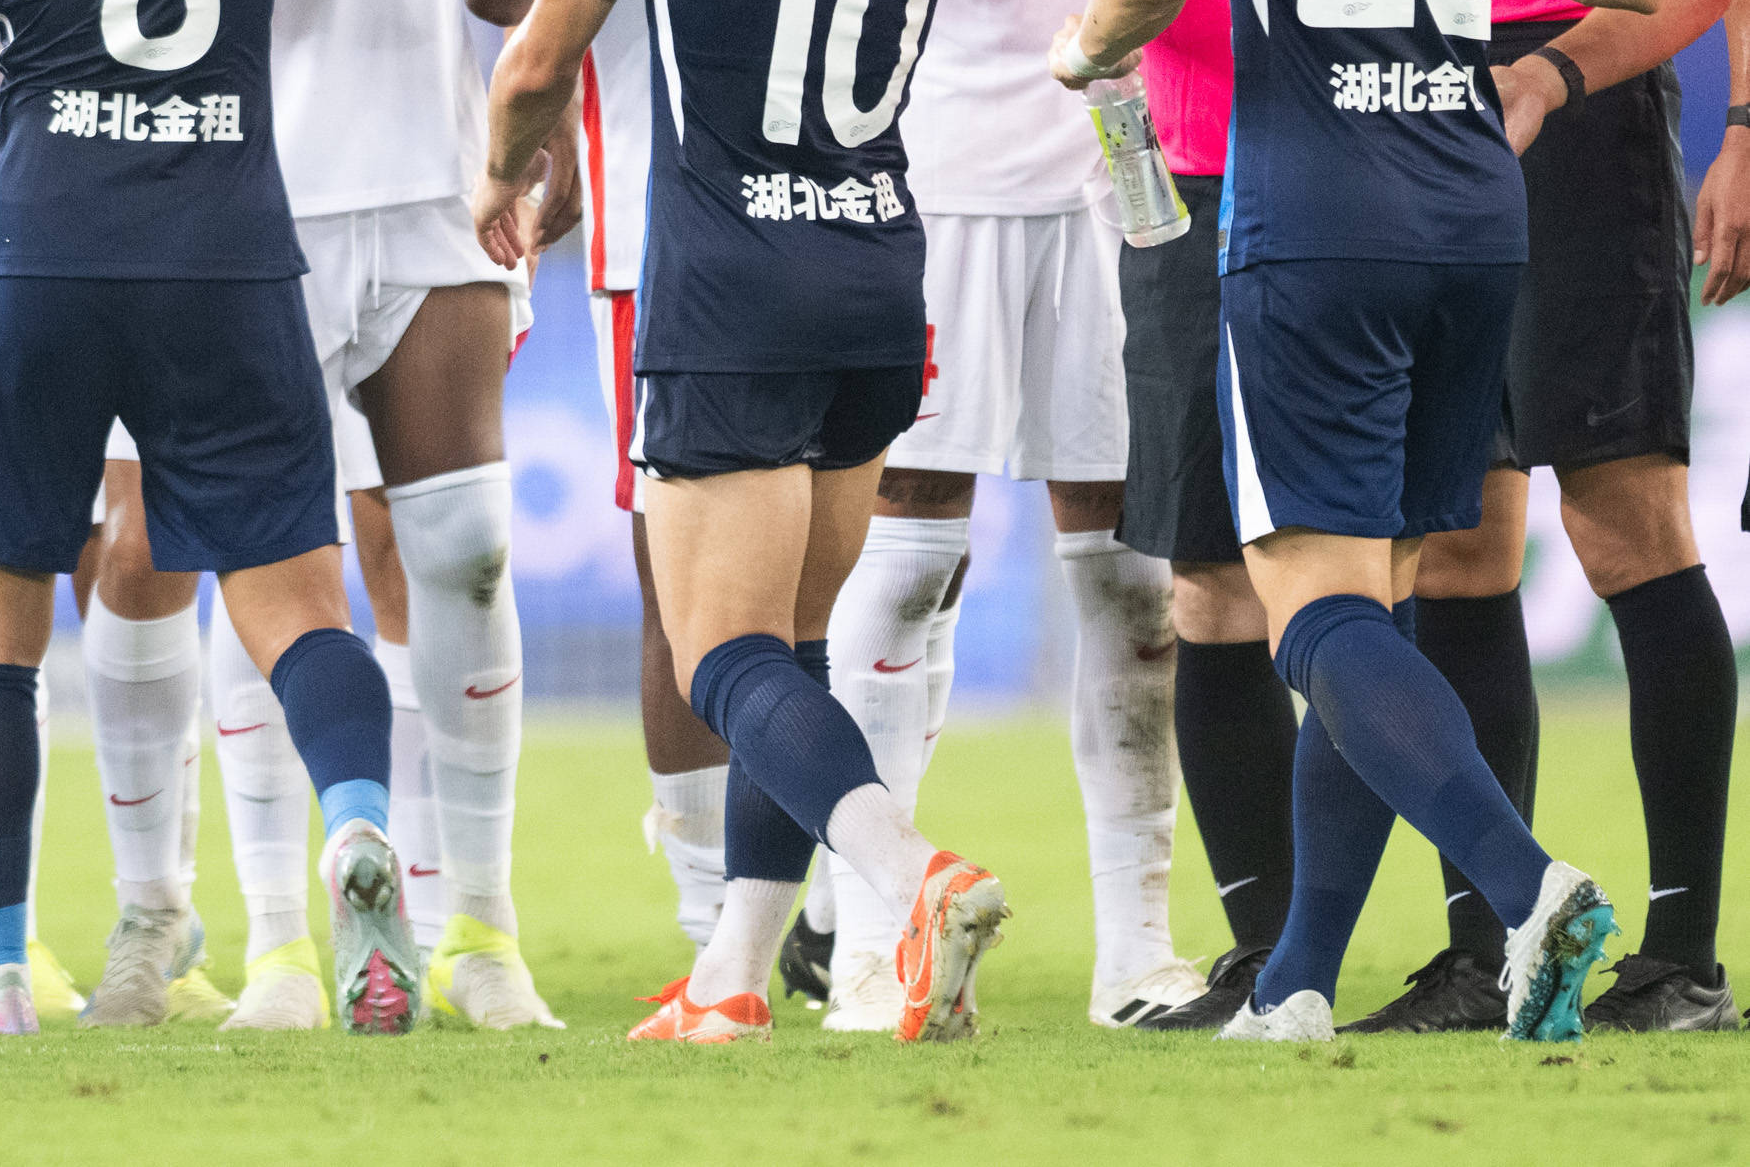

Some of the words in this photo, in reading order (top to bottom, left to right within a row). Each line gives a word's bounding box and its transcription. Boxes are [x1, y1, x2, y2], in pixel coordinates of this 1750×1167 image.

[1329, 60, 1486, 114] 湖北金
[47, 89, 244, 143] 湖北金租
[740, 171, 906, 224] 湖北金租
